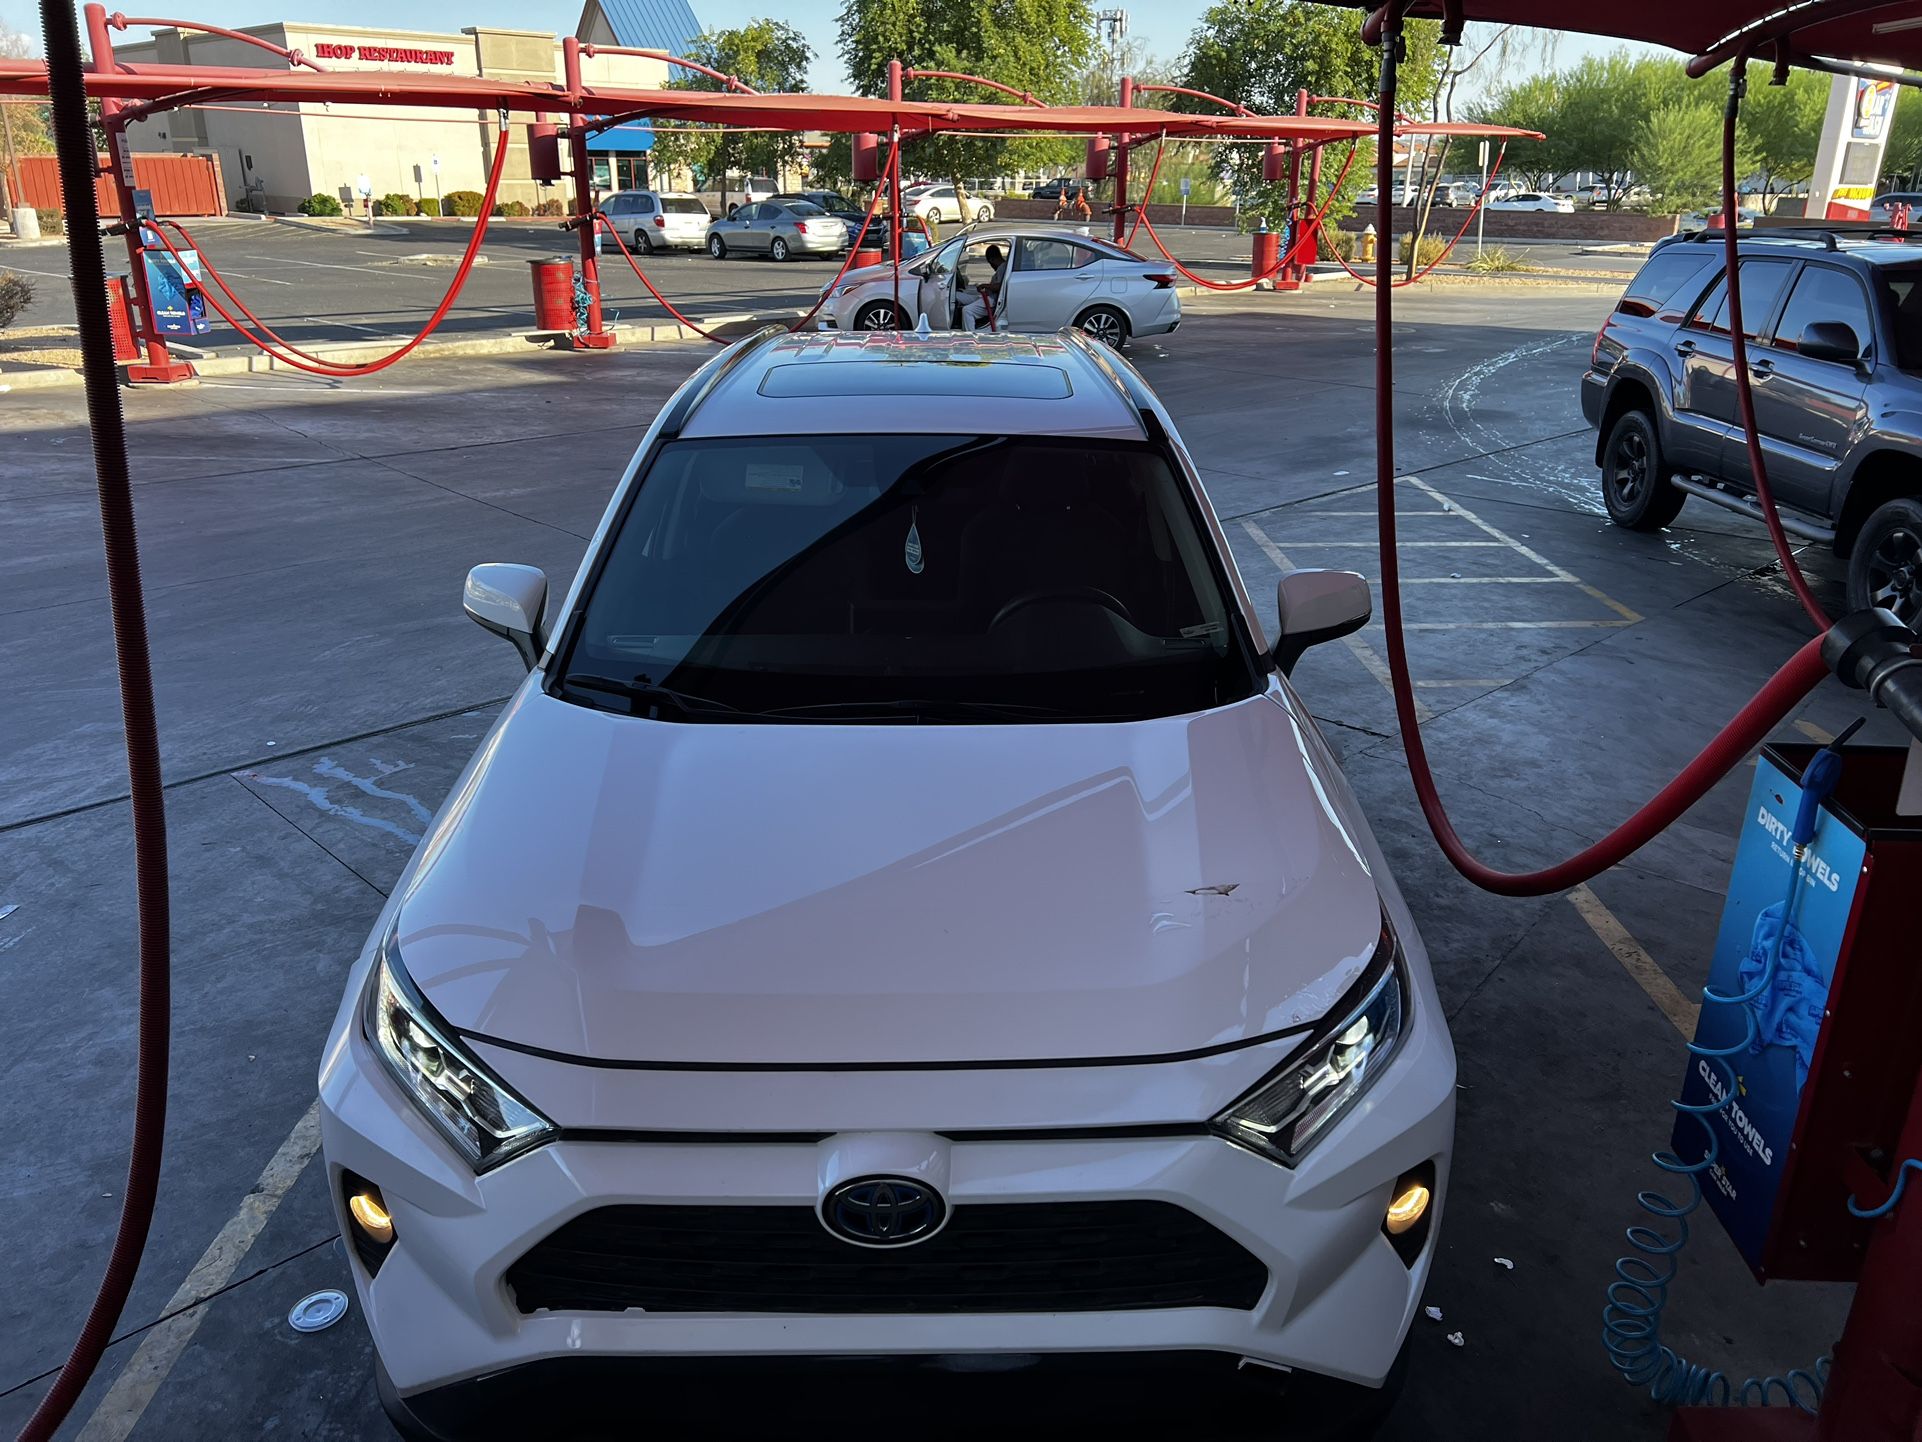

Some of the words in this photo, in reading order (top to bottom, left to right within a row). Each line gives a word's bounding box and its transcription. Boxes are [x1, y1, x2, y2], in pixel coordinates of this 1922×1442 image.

[315, 43, 356, 59] IHOP
[357, 46, 455, 65] RESTAURANT
[1757, 806, 1792, 846] DIRTY
[1793, 845, 1840, 892] OWELS
[1728, 1119, 1738, 1135] YOU
[1737, 1130, 1745, 1144] TO
[1743, 1140, 1753, 1157] USE
[1730, 1100, 1773, 1166] TOWELS
[1703, 1149, 1723, 1180] SPER
[1721, 1175, 1737, 1201] STAR
